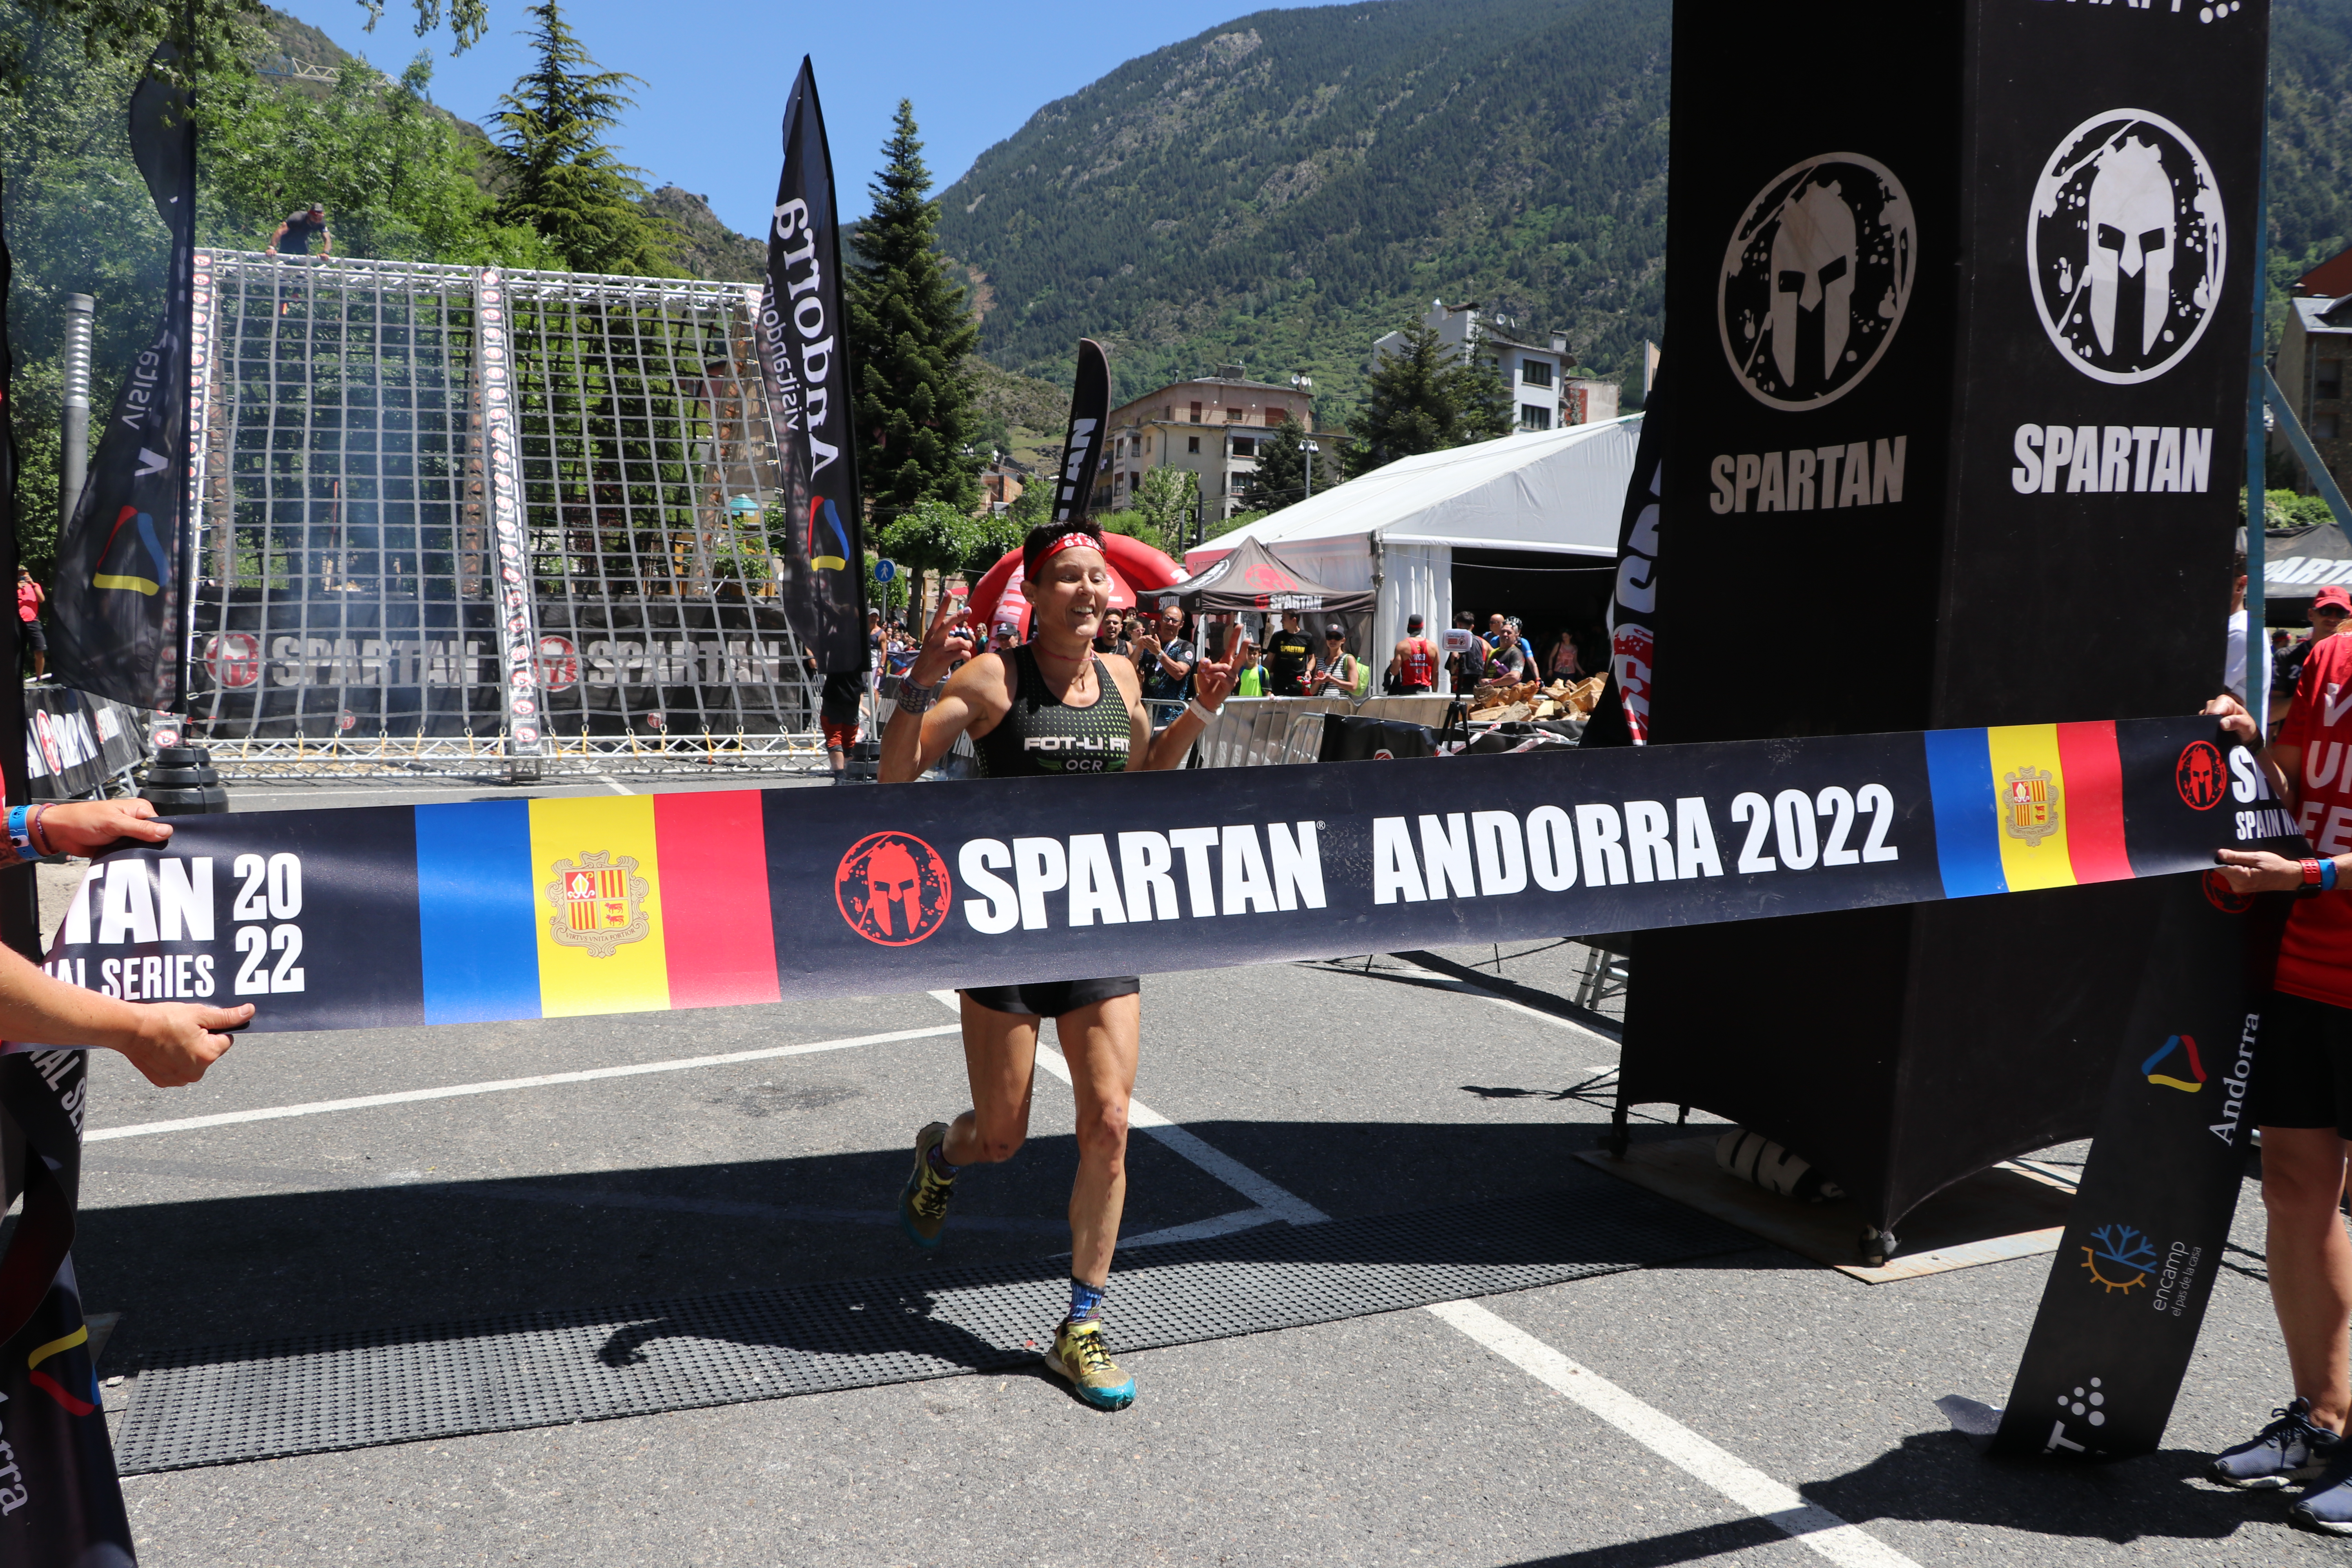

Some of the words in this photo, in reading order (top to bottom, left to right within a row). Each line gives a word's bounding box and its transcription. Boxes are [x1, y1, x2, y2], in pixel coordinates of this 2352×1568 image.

[2013, 423, 2213, 494] SPARTAN
[1710, 436, 1907, 514] SPARTAN
[1270, 595, 1322, 610] SPARTAN
[1280, 645, 1305, 653] SPARTAN
[1024, 736, 1103, 751] FOT-LI
[1109, 737, 1130, 752] FIT
[1066, 760, 1103, 771] OCR
[2236, 808, 2282, 840] SPAIN
[1373, 796, 1724, 905] ANDORRA
[1731, 783, 1898, 874] 2022
[233, 853, 302, 921] 20
[566, 932, 588, 941] VIRTVS
[610, 928, 636, 940] FORTIOR
[235, 924, 305, 995] 22
[102, 955, 215, 1001] SERIES
[2209, 1013, 2259, 1147] Andorra
[2189, 1247, 2201, 1267] casa
[2153, 1241, 2190, 1311] encamp
[2182, 1267, 2195, 1276] la
[2179, 1277, 2192, 1289] de
[2175, 1290, 2187, 1308] pas
[2171, 1306, 2182, 1316] el
